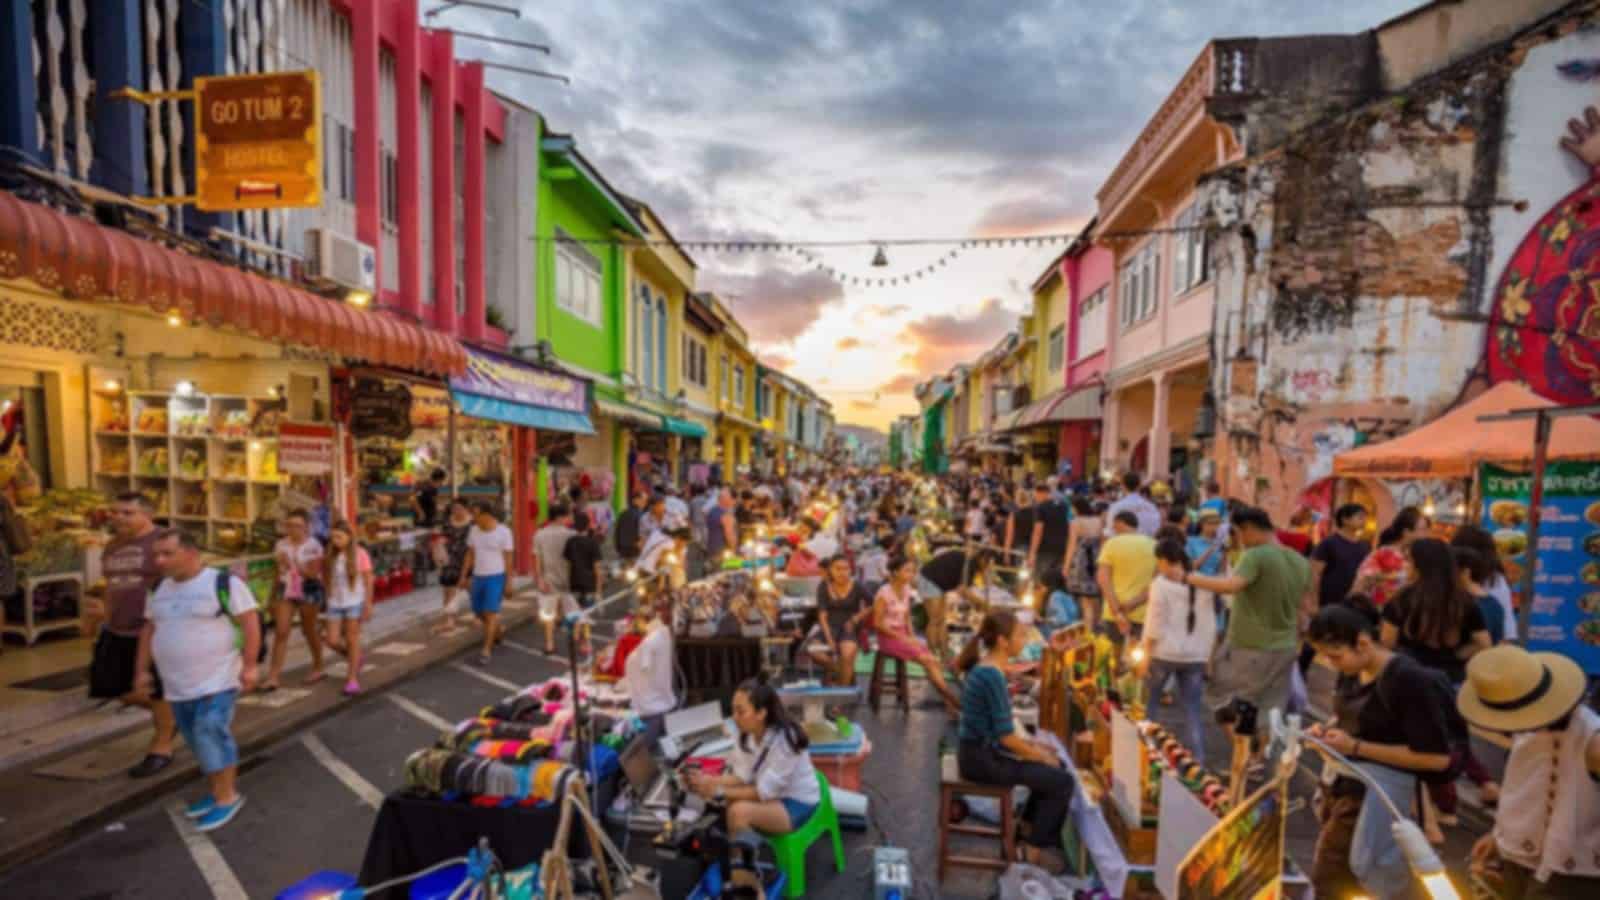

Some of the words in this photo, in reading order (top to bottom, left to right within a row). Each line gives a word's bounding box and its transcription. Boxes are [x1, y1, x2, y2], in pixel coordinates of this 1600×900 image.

[211, 99, 239, 124] GO
[241, 95, 283, 121] TUM
[288, 95, 304, 120] 2
